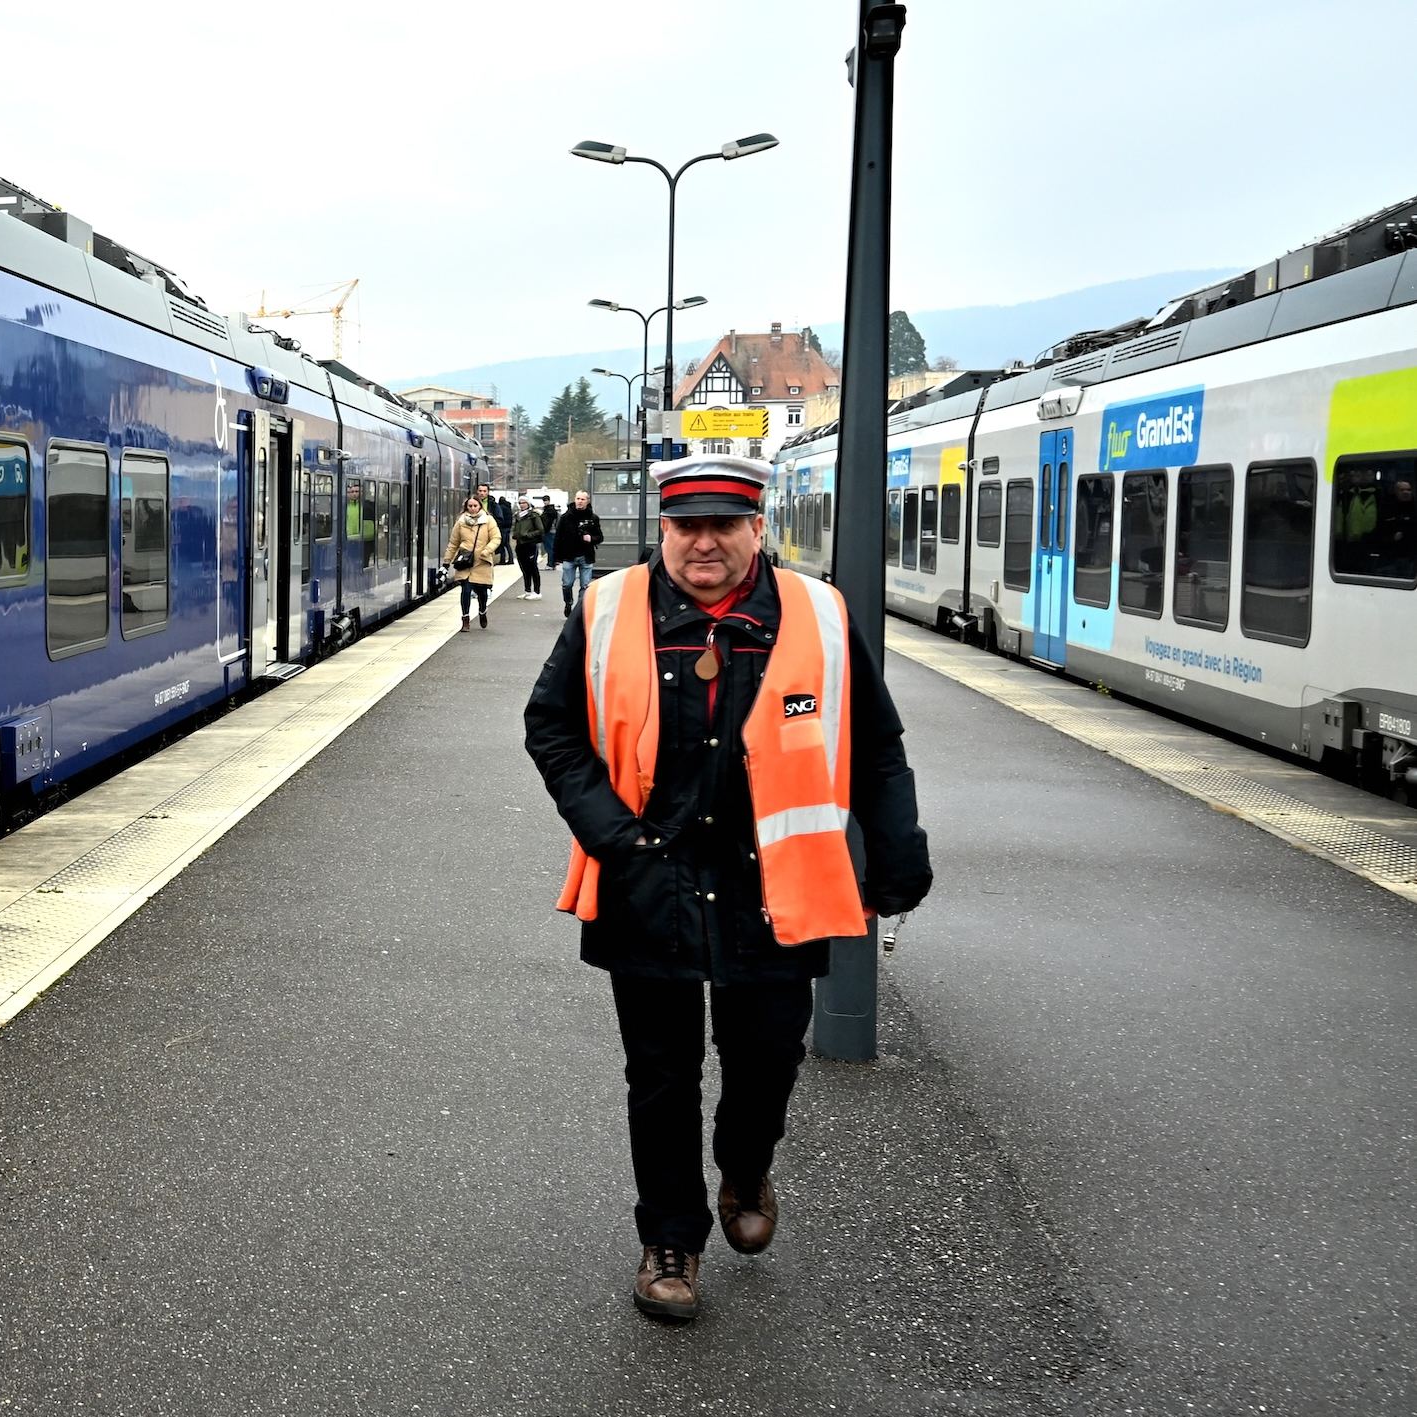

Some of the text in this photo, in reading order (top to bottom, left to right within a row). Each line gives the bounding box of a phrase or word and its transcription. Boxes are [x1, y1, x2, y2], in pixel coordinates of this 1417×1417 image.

[1104, 421, 1132, 470] fluo
[1144, 635, 1262, 684] Voyagez en grand avec la Région
[785, 699, 817, 715] SNCF
